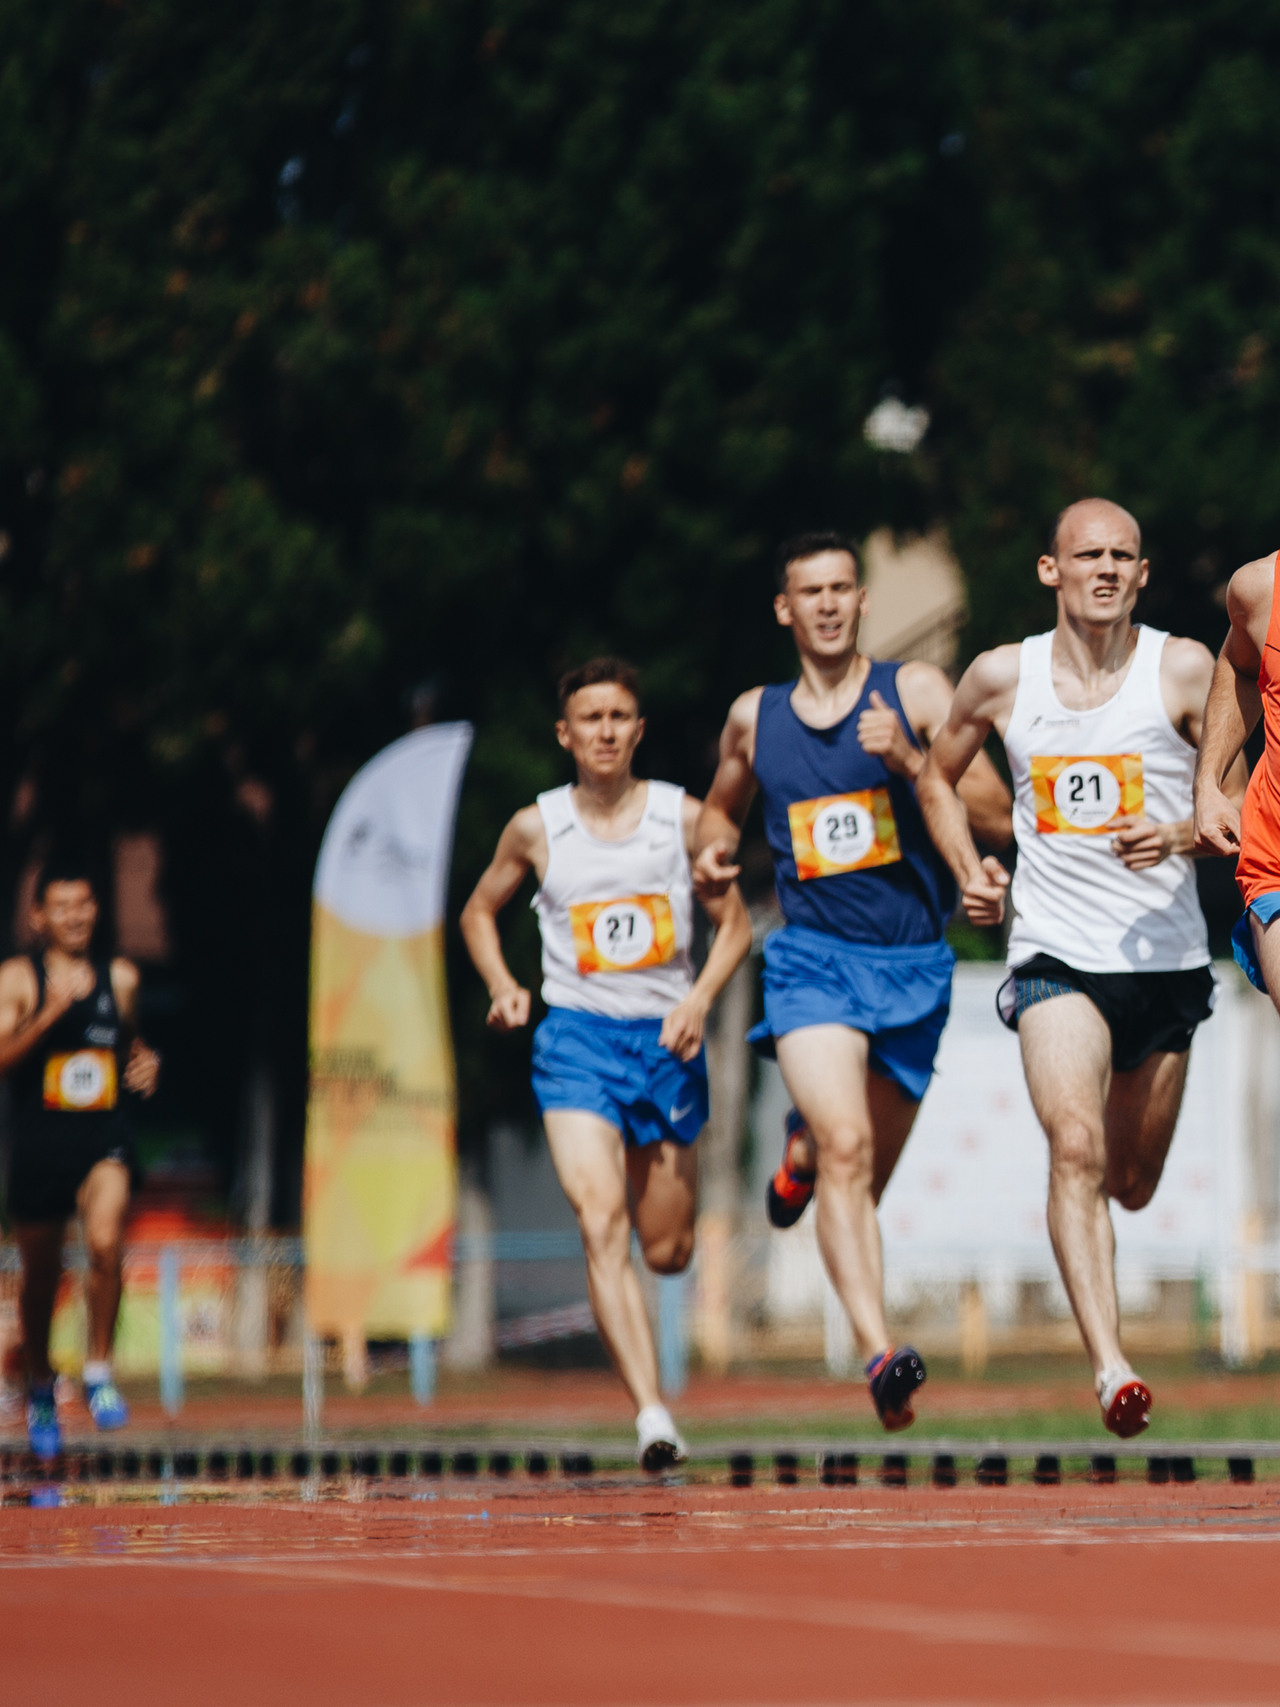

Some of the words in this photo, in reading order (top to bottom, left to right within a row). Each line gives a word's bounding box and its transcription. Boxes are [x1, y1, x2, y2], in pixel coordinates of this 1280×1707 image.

[1069, 774, 1102, 802] 21
[826, 812, 859, 842] 29
[606, 912, 636, 940] 27
